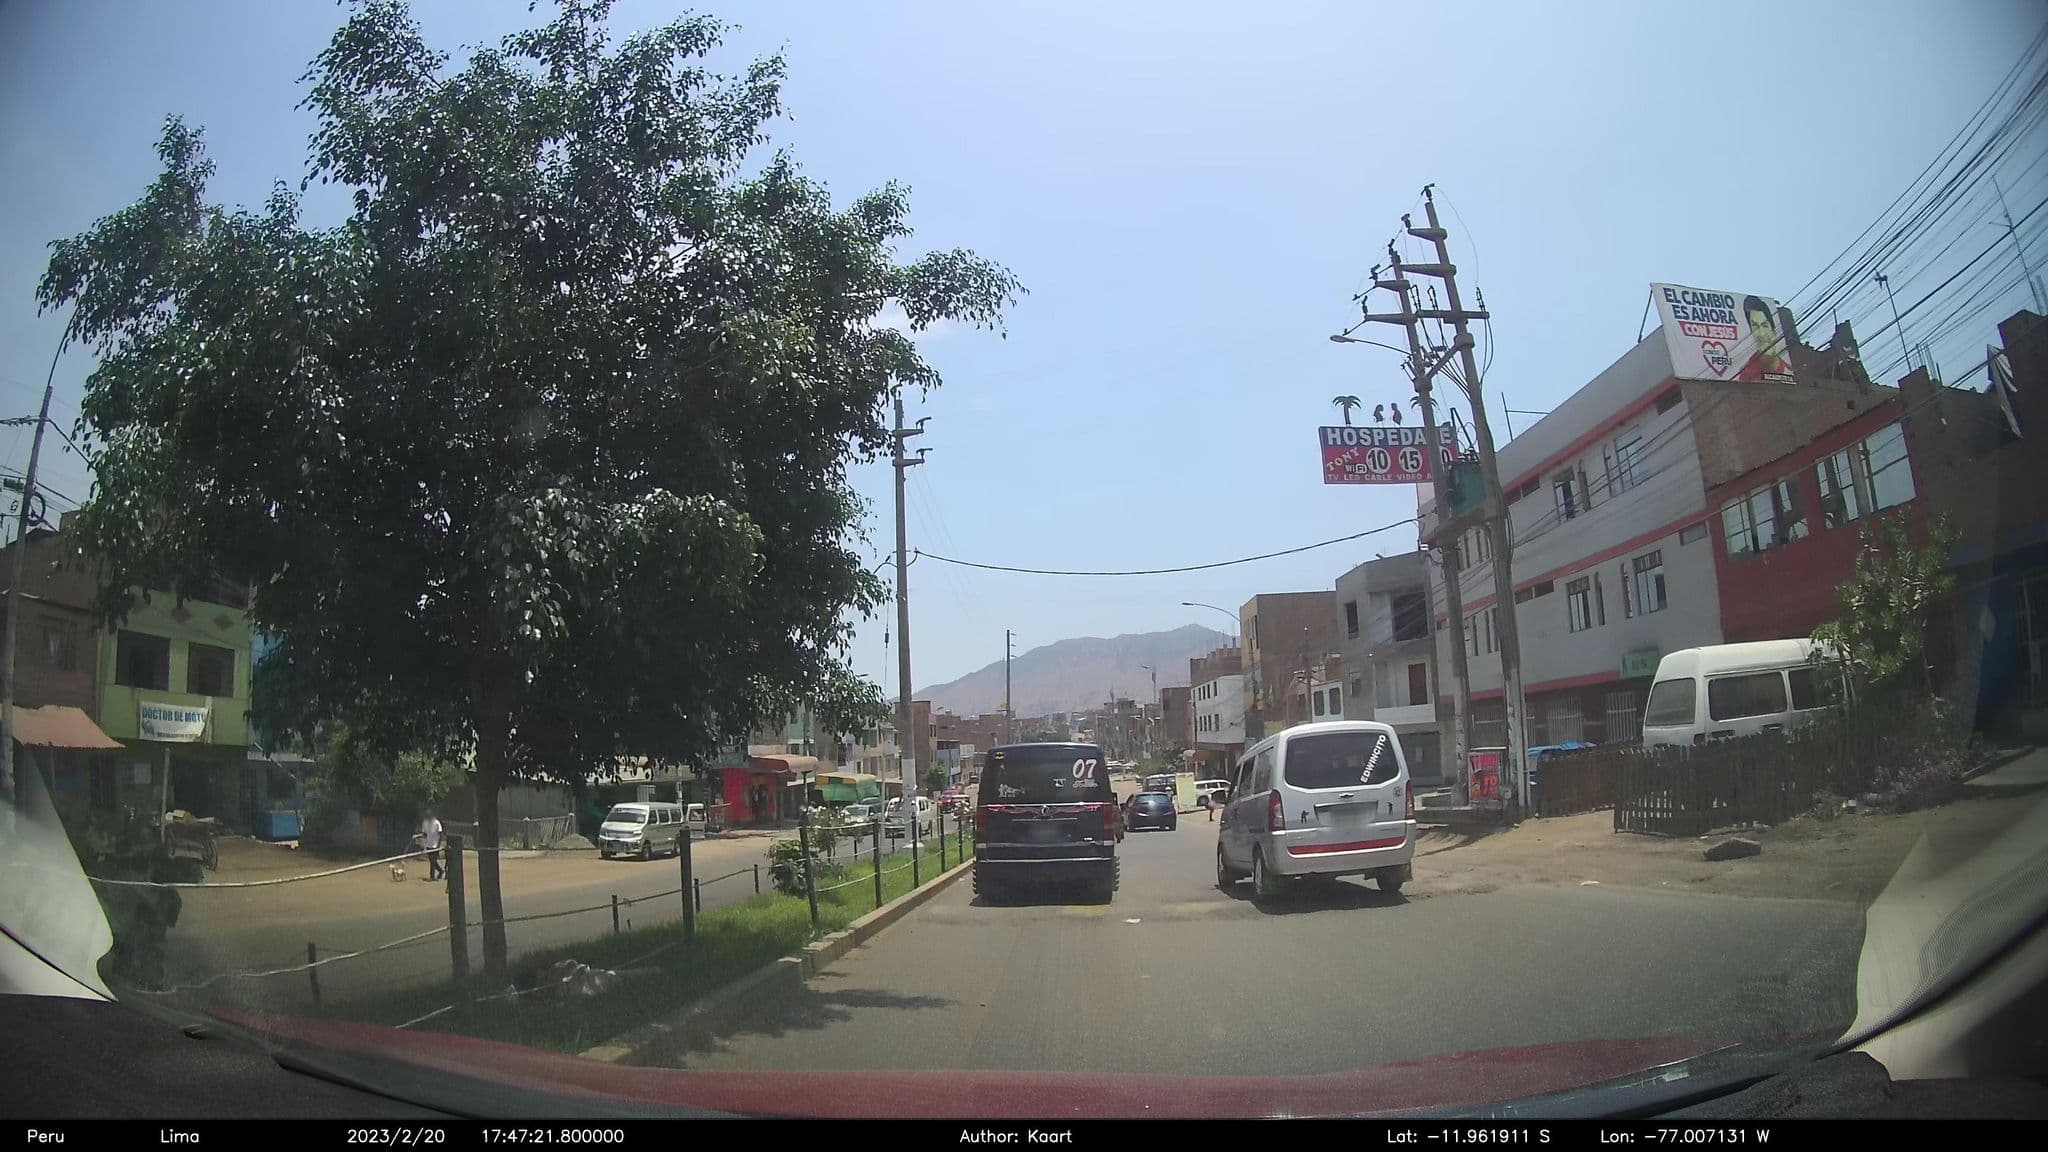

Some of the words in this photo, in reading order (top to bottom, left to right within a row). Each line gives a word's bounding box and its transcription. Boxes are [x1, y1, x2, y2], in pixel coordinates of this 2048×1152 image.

[1663, 288, 1682, 304] EL
[1681, 290, 1736, 309] CAMBIO
[1672, 304, 1691, 320] ES
[1691, 306, 1739, 325] AHORA
[1684, 323, 1707, 337] CON
[1327, 427, 1451, 446] HOSPEDAE
[1326, 447, 1360, 472] TONY
[1367, 450, 1390, 471] 10
[1401, 450, 1421, 471] 15
[143, 707, 173, 721] DOCTOR
[174, 711, 183, 722] DE
[1072, 758, 1097, 779] 07
[1360, 734, 1386, 784] EDWINCITO
